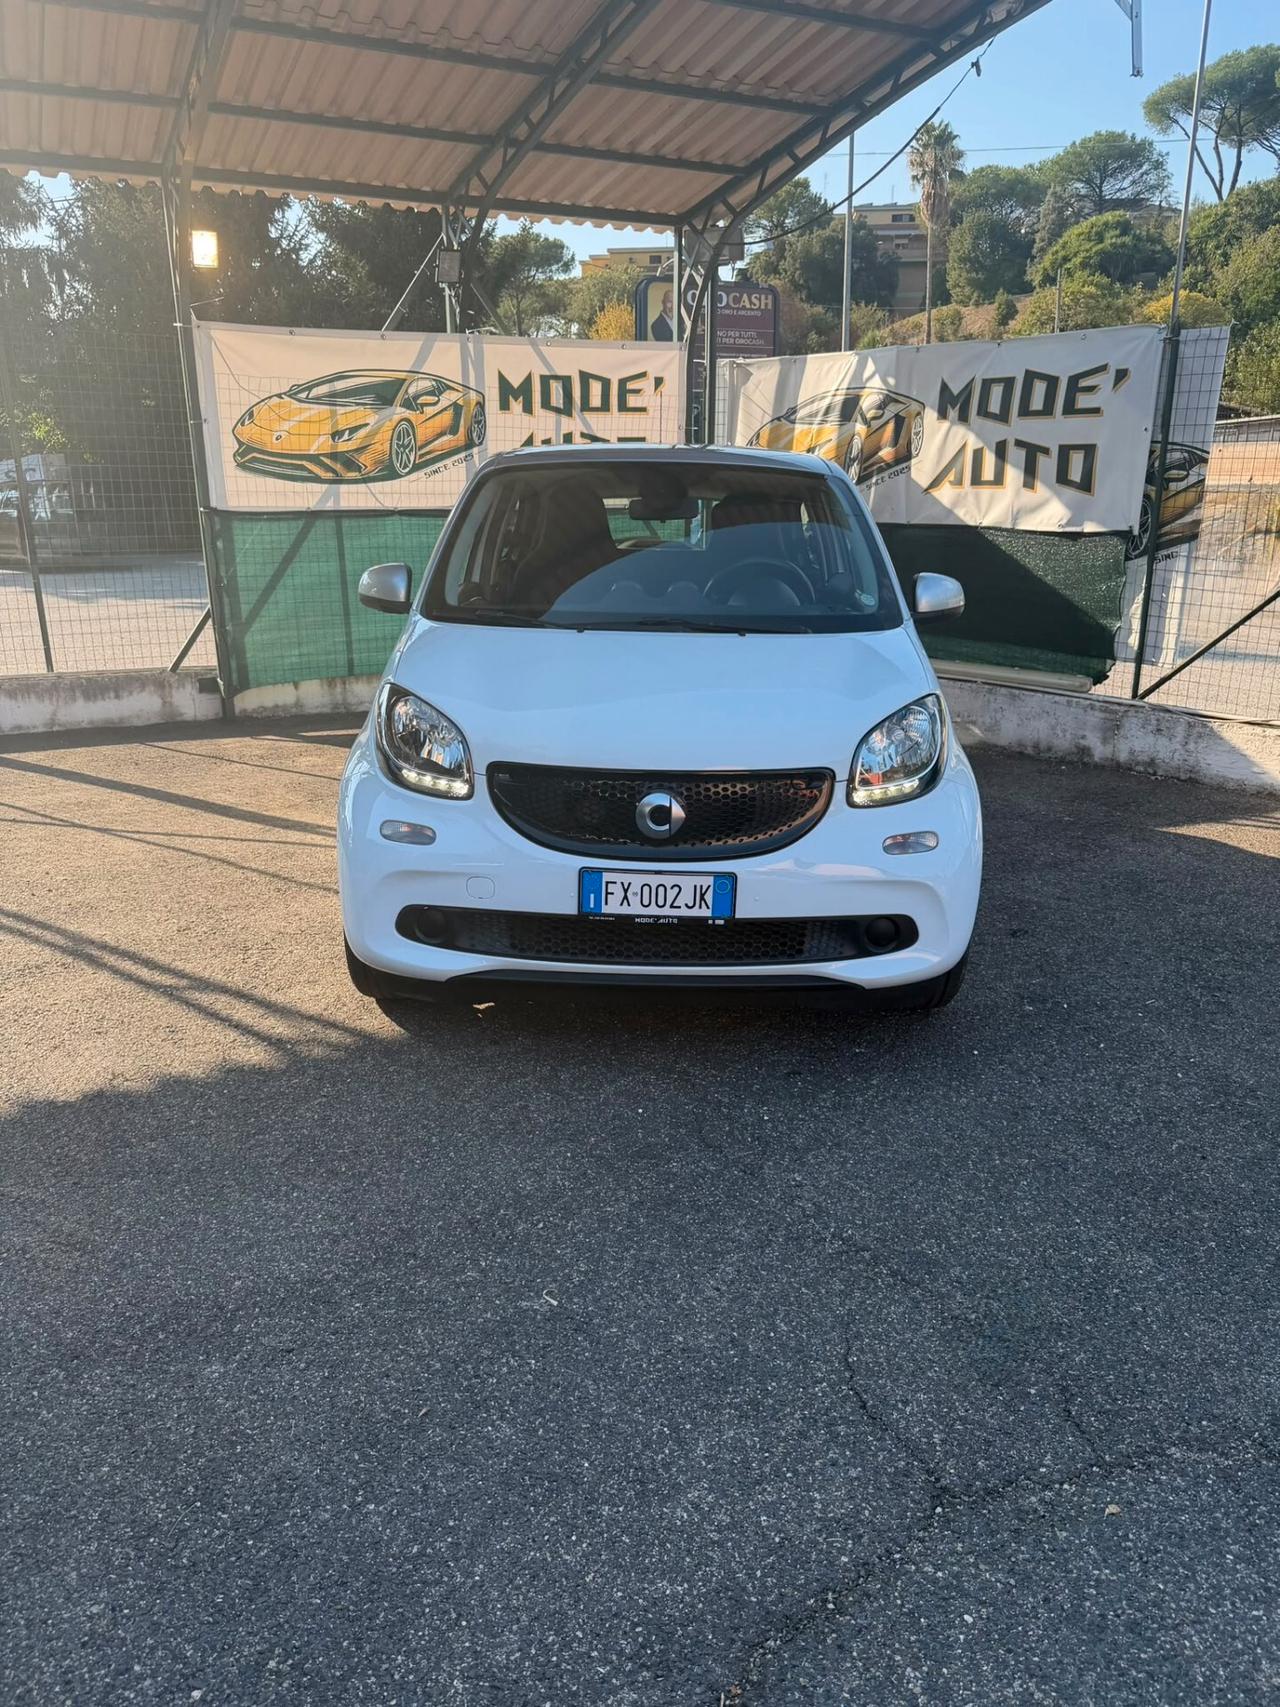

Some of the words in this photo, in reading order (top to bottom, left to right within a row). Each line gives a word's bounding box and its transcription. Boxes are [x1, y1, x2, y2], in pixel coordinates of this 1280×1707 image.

[686, 289, 773, 310] OOCASH
[722, 337, 734, 345] PER
[498, 369, 666, 418] MODE'
[937, 362, 1131, 427] MODE'
[424, 463, 450, 479] SINCE
[921, 438, 1097, 497] AUTO
